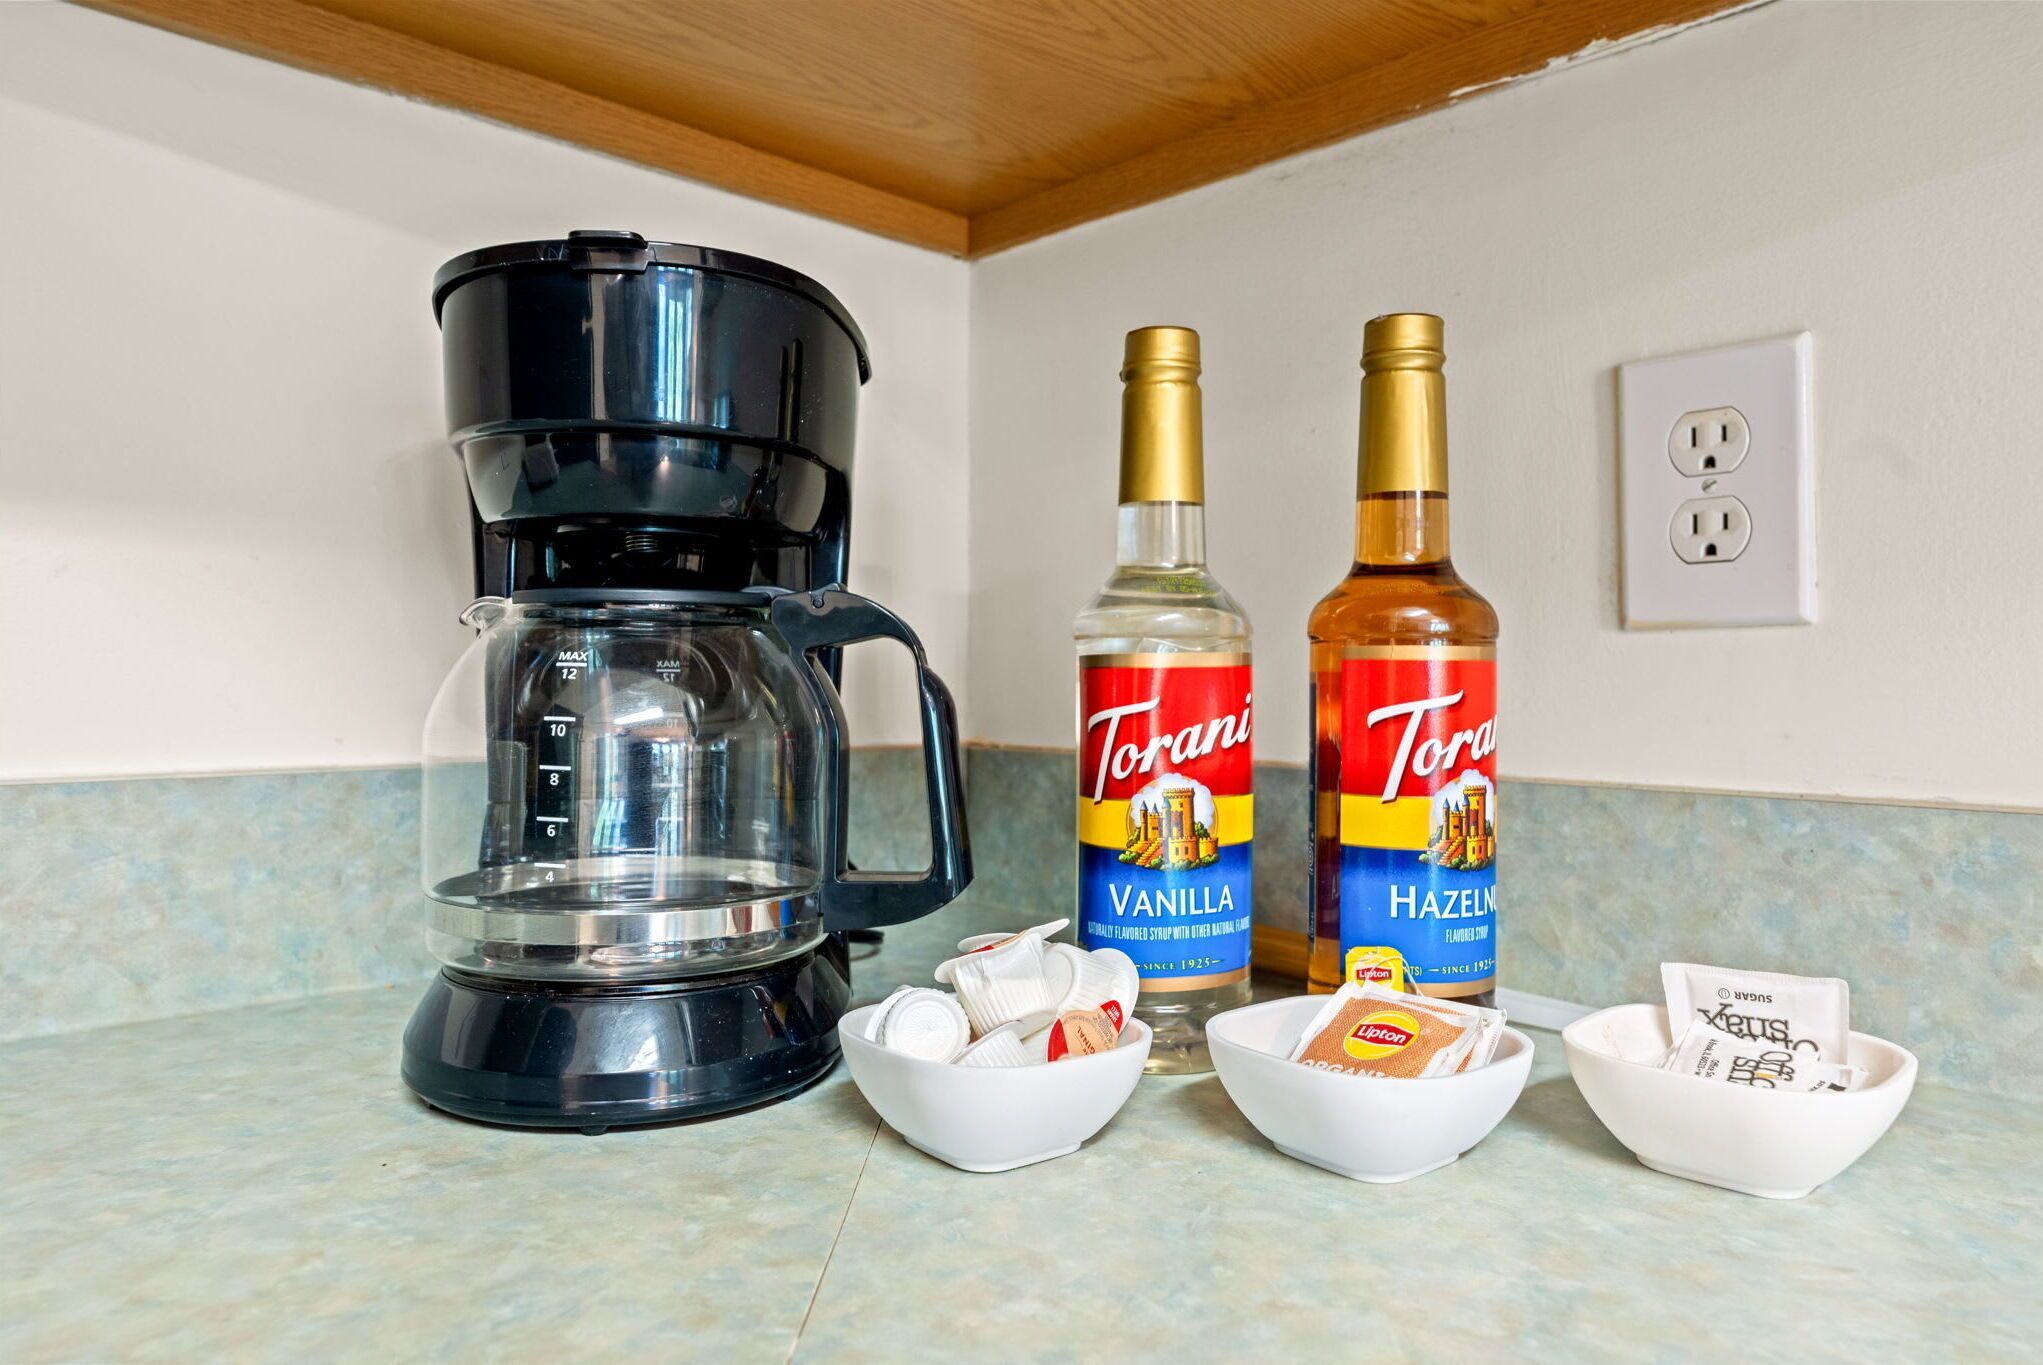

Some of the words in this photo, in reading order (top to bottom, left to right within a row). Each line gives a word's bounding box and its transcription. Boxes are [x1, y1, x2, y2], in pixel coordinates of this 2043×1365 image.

[558, 651, 588, 661] MAX
[562, 668, 578, 680] 12
[550, 723, 566, 737] 10
[1088, 693, 1252, 805] Torani
[549, 773, 559, 786] 8
[546, 824, 556, 837] 6
[545, 871, 554, 882] 4
[1109, 883, 1234, 917] VANILLA
[1115, 925, 1148, 940] FLAVORED
[1149, 927, 1172, 941] SYRUP
[1172, 926, 1190, 940] WITH
[1191, 924, 1210, 939] OTHER
[1446, 927, 1474, 943] FLAVORED
[1143, 962, 1176, 970] SINCE
[1182, 957, 1210, 970] 1925
[1442, 965, 1470, 974] SINCE
[1474, 958, 1492, 972] 1925
[1360, 971, 1389, 980] Lipton
[1734, 991, 1772, 1003] SUGAR
[1357, 1025, 1406, 1044] Lipton
